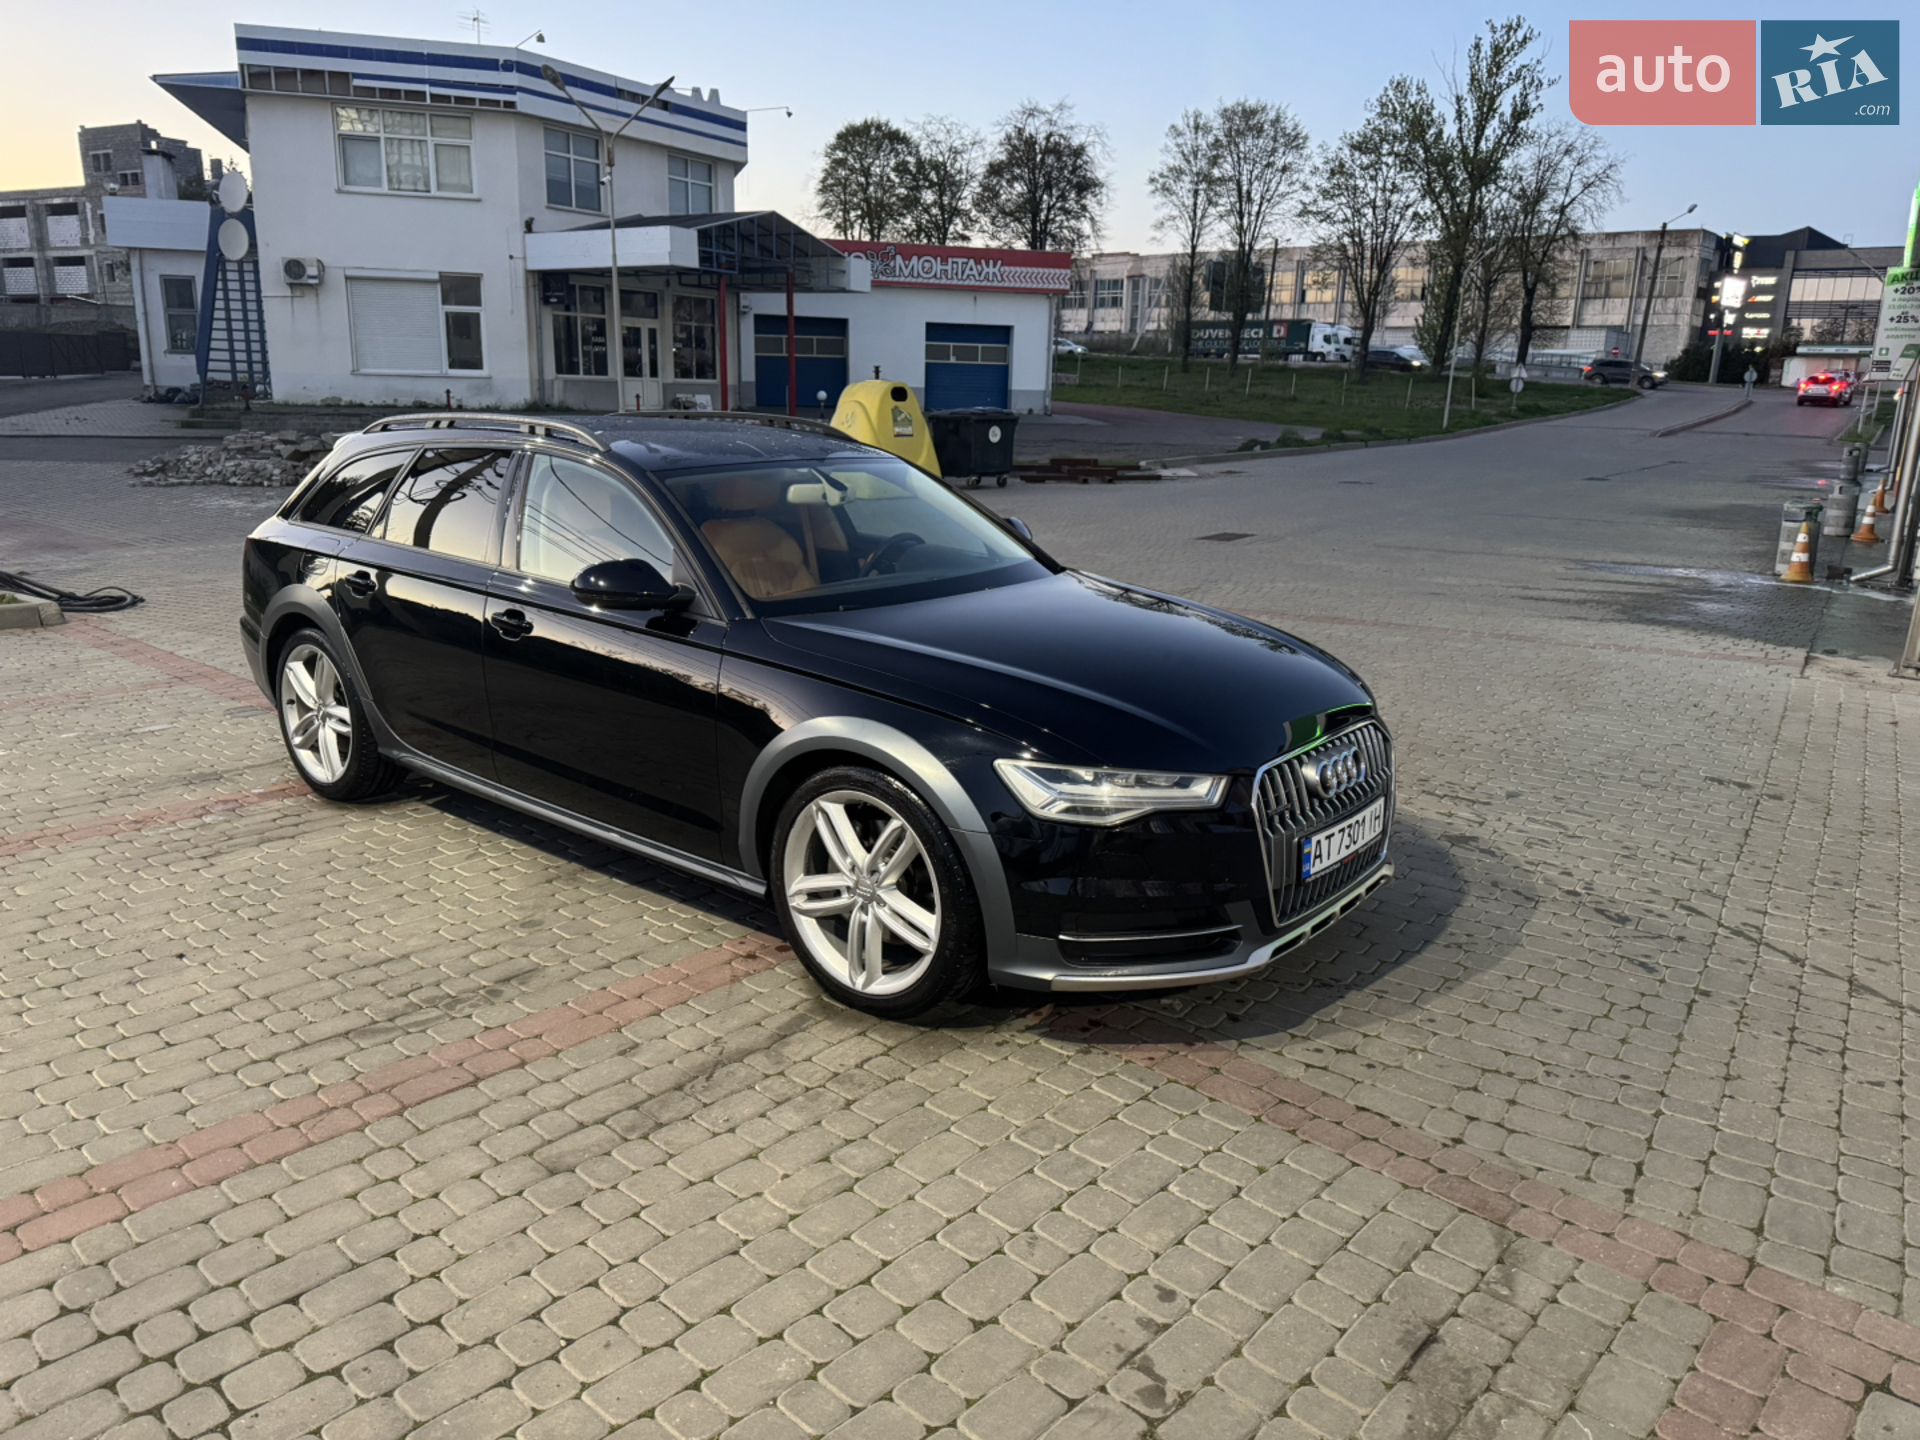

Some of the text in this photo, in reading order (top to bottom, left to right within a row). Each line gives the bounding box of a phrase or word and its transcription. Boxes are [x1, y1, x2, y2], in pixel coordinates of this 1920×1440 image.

[895, 253, 1002, 283] МОНТАЖ
[1889, 315, 1919, 323] +25%
[1312, 832, 1335, 868] AT
[1337, 814, 1366, 856] 7301
[1368, 803, 1382, 836] IH
